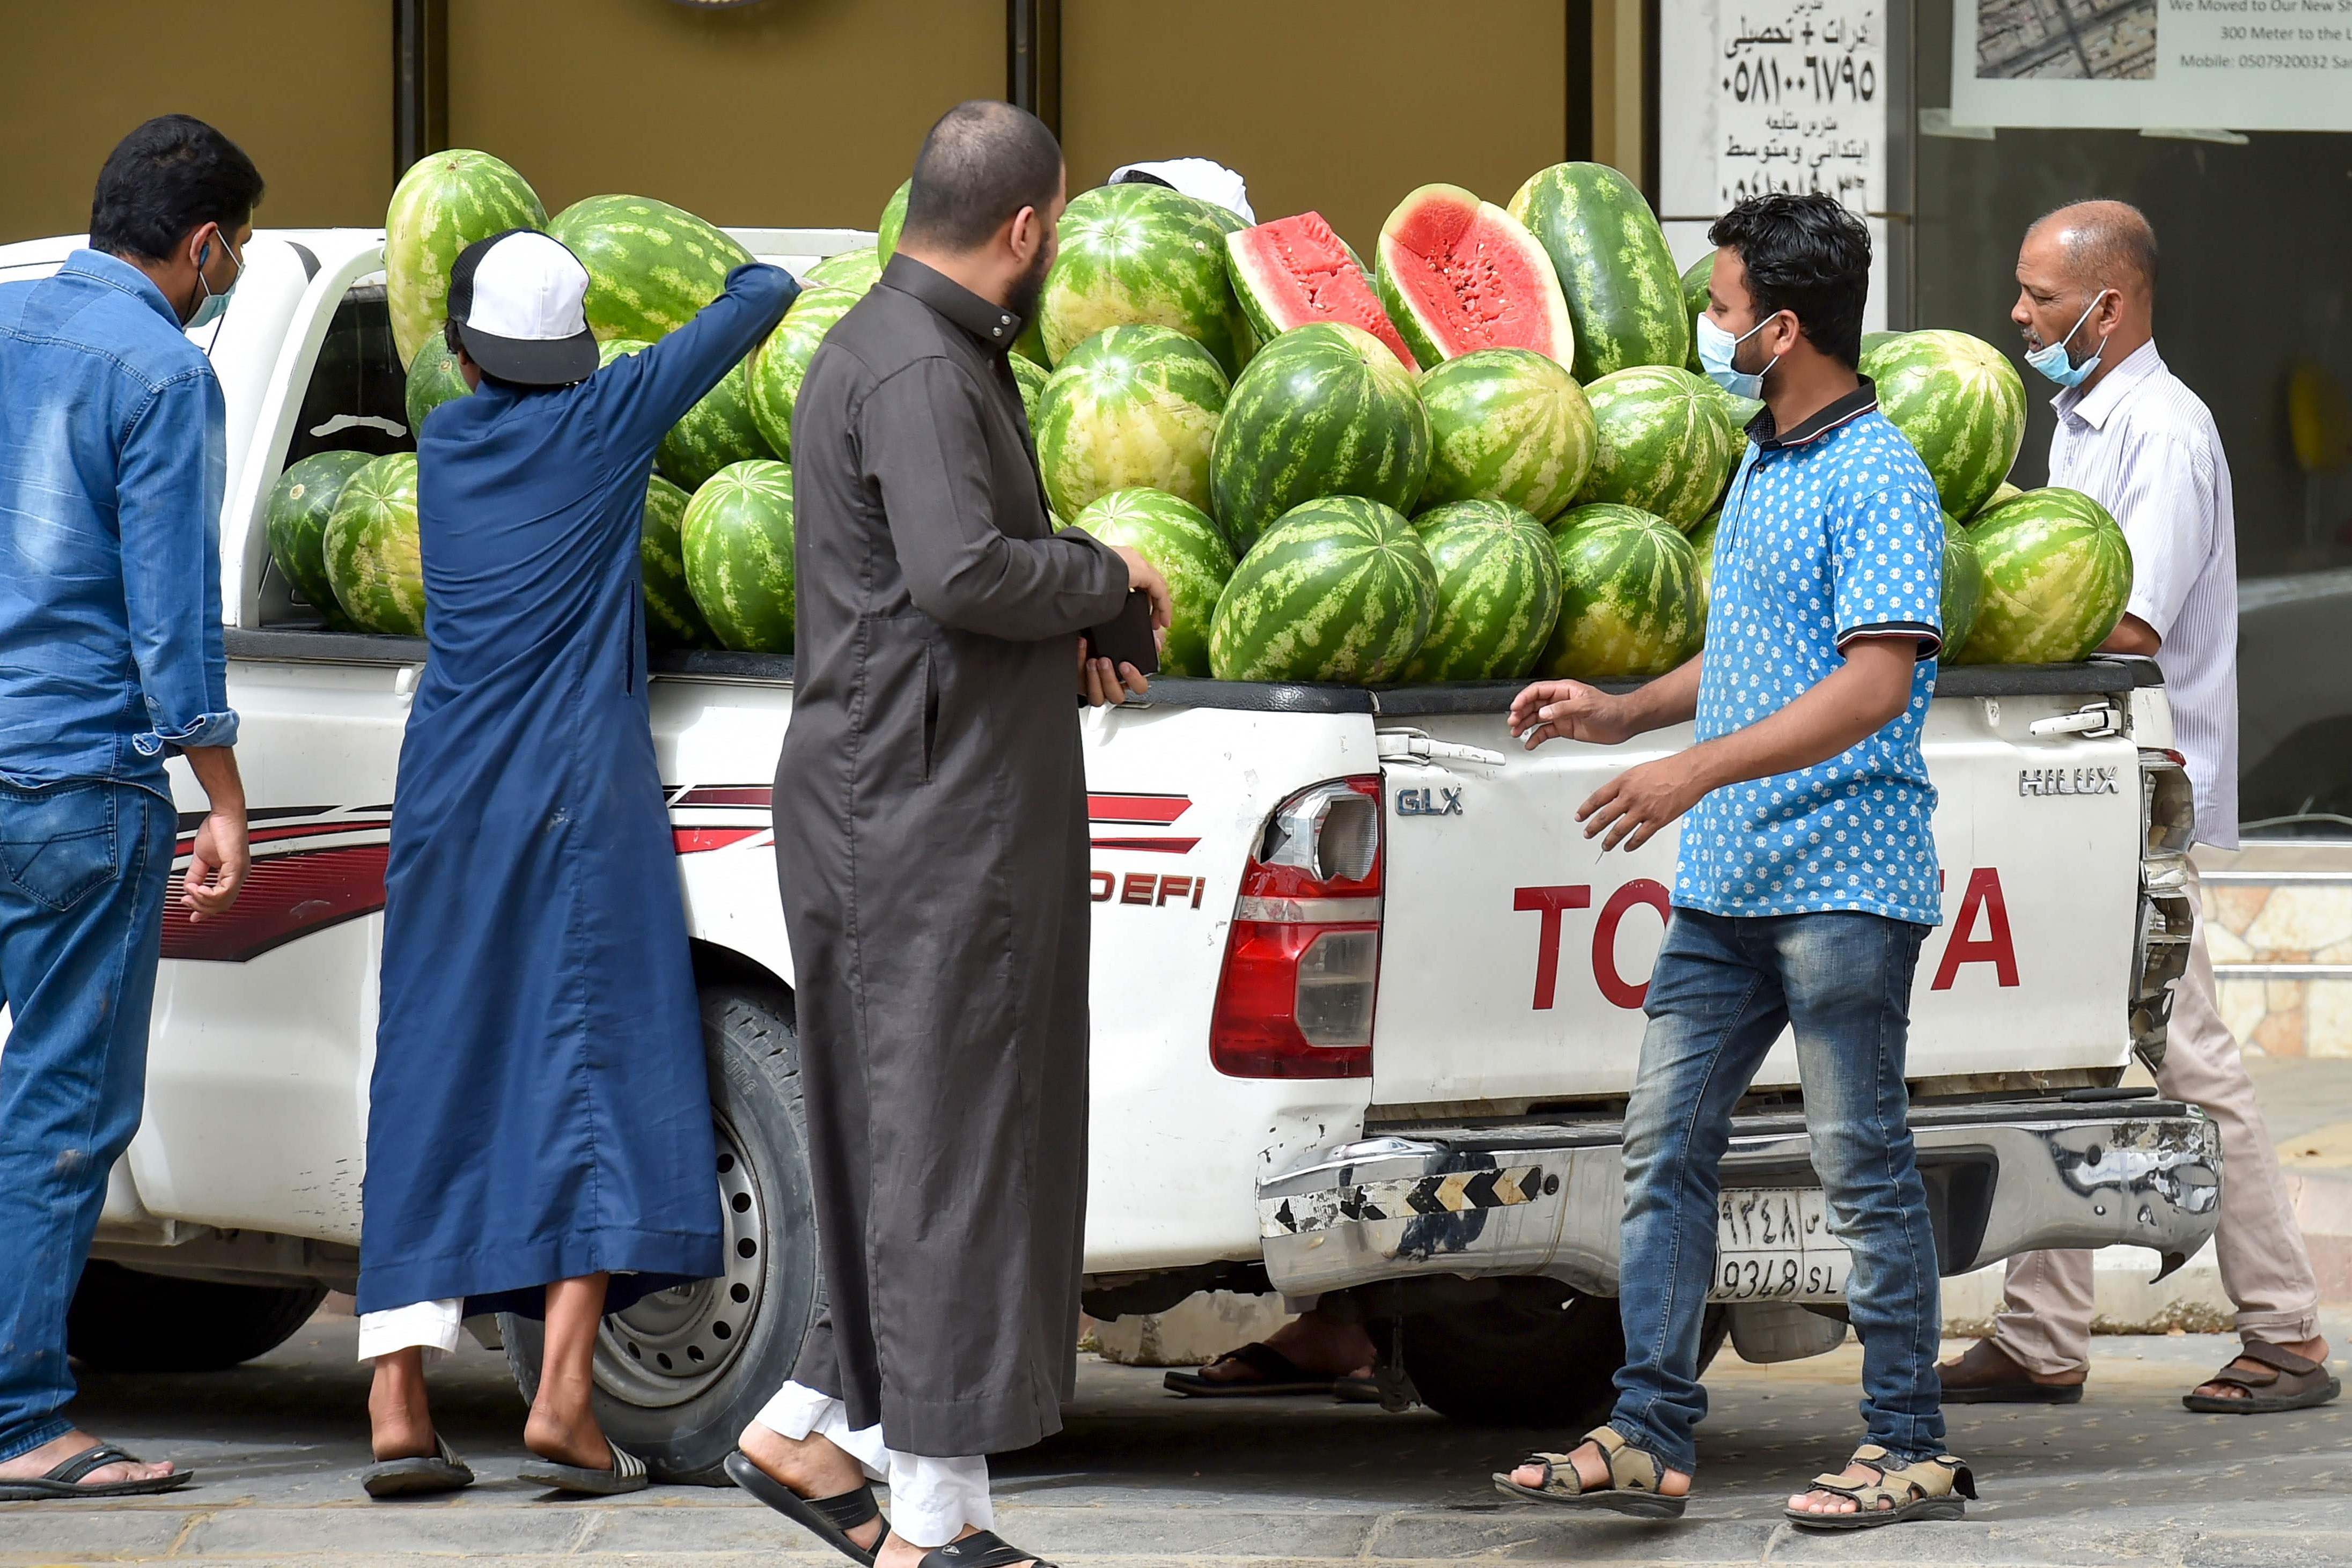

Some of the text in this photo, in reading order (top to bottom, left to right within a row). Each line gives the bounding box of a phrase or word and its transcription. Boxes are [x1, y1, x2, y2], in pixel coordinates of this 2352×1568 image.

[2170, 0, 2193, 11] We
[2198, 0, 2247, 11] Moved
[2252, 0, 2266, 11] to
[2271, 0, 2296, 11] Our
[2302, 0, 2334, 11] New
[2221, 27, 2246, 40] 300
[2251, 27, 2294, 40] Meter
[2298, 27, 2314, 40] to
[2318, 27, 2342, 40] the
[2180, 54, 2233, 68] Mobile:
[1722, 55, 1876, 104] ٠٥٨١٠٠٦٧٩٥
[2019, 767, 2119, 797] HILUX
[1395, 787, 1463, 816] GLX
[1513, 867, 2020, 1010] TOA
[1717, 1258, 1798, 1299] 9348
